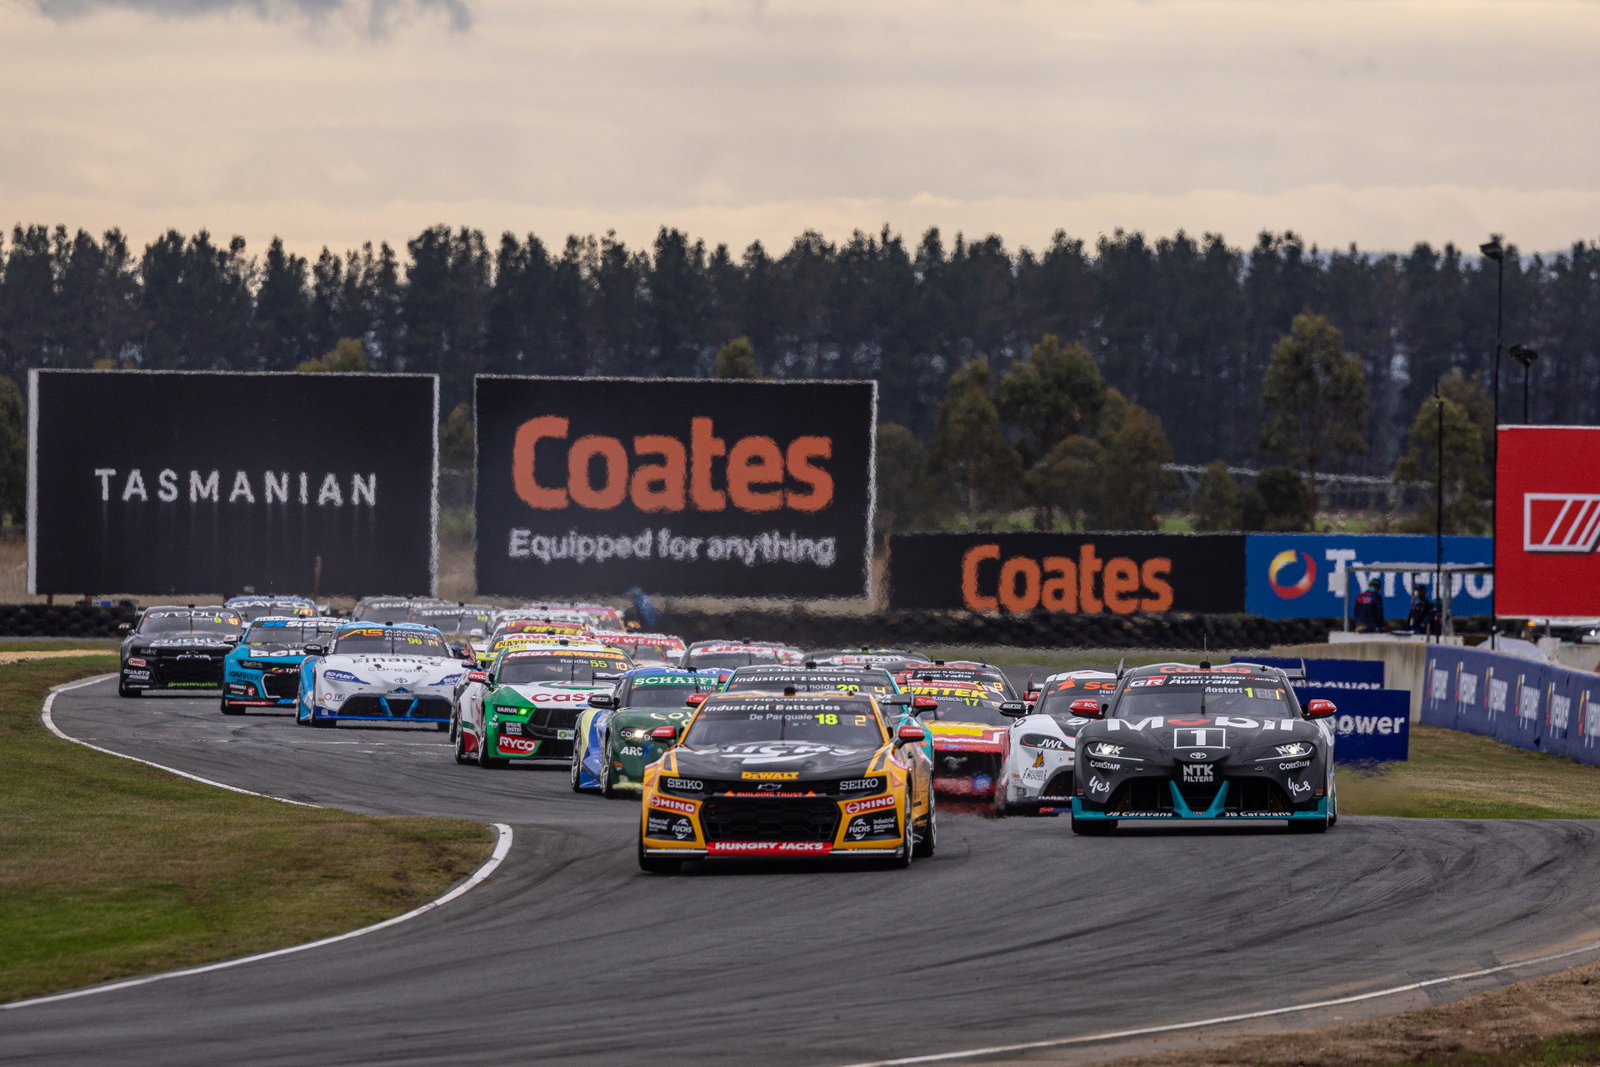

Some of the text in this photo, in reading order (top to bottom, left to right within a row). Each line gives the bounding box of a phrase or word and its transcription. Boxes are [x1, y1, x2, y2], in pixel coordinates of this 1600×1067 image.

[512, 415, 834, 513] Coates
[95, 468, 377, 506] TASMANIAN
[509, 528, 836, 566] Equipped for anything
[962, 543, 1174, 614] Coates
[407, 637, 422, 645] 96
[553, 651, 625, 660] REWARDS
[590, 660, 608, 668] 55
[615, 662, 627, 671] 10
[1159, 666, 1252, 674] Coates
[793, 683, 836, 691] Reynolds
[1130, 679, 1162, 688] GR
[900, 686, 989, 699] PIRTEK
[1204, 686, 1244, 694] Mostert
[1244, 687, 1253, 698] 1
[963, 697, 980, 707] 17
[497, 706, 518, 714] NARVA
[704, 703, 841, 712] Industrial Batteries
[815, 713, 839, 726] 18
[854, 715, 867, 727] 2
[1107, 716, 1294, 732] Mobil
[1190, 729, 1207, 746] 1
[500, 736, 536, 751] RYCO
[1037, 738, 1064, 749] JWL
[1182, 764, 1214, 775] NTK
[1183, 775, 1214, 783] FILTERS
[667, 778, 704, 791] SEIKO
[839, 778, 879, 791] SEIKO
[660, 798, 696, 813] HINO
[860, 796, 895, 810] HINO
[649, 817, 670, 825] Industrial
[873, 816, 896, 824] Industrial
[649, 823, 668, 831] Batteries
[672, 824, 692, 834] FUCHS
[848, 824, 871, 834] FUCHS
[715, 842, 778, 850] HUNGRY
